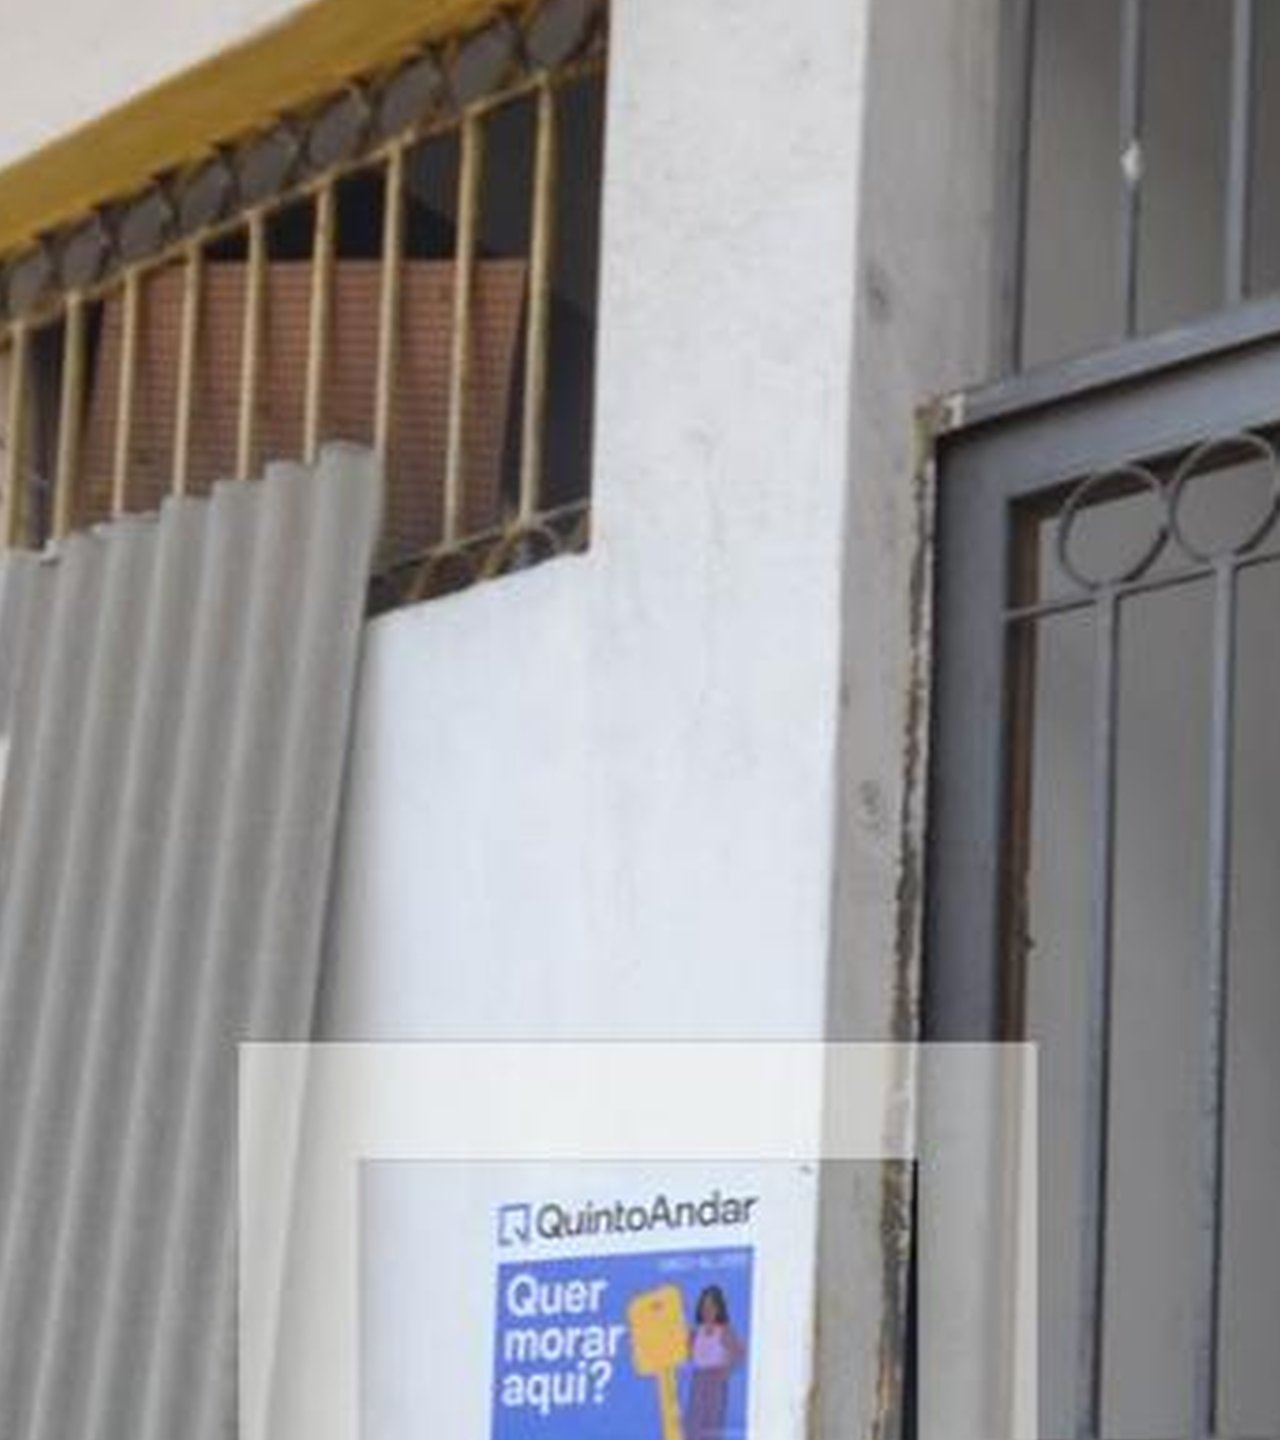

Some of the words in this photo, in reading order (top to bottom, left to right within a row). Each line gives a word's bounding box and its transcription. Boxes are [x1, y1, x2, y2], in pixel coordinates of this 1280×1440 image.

[536, 1190, 759, 1240] QuintoAndar
[506, 1274, 608, 1317] Quer
[504, 1325, 623, 1361] morar
[501, 1361, 612, 1414] aqui?
